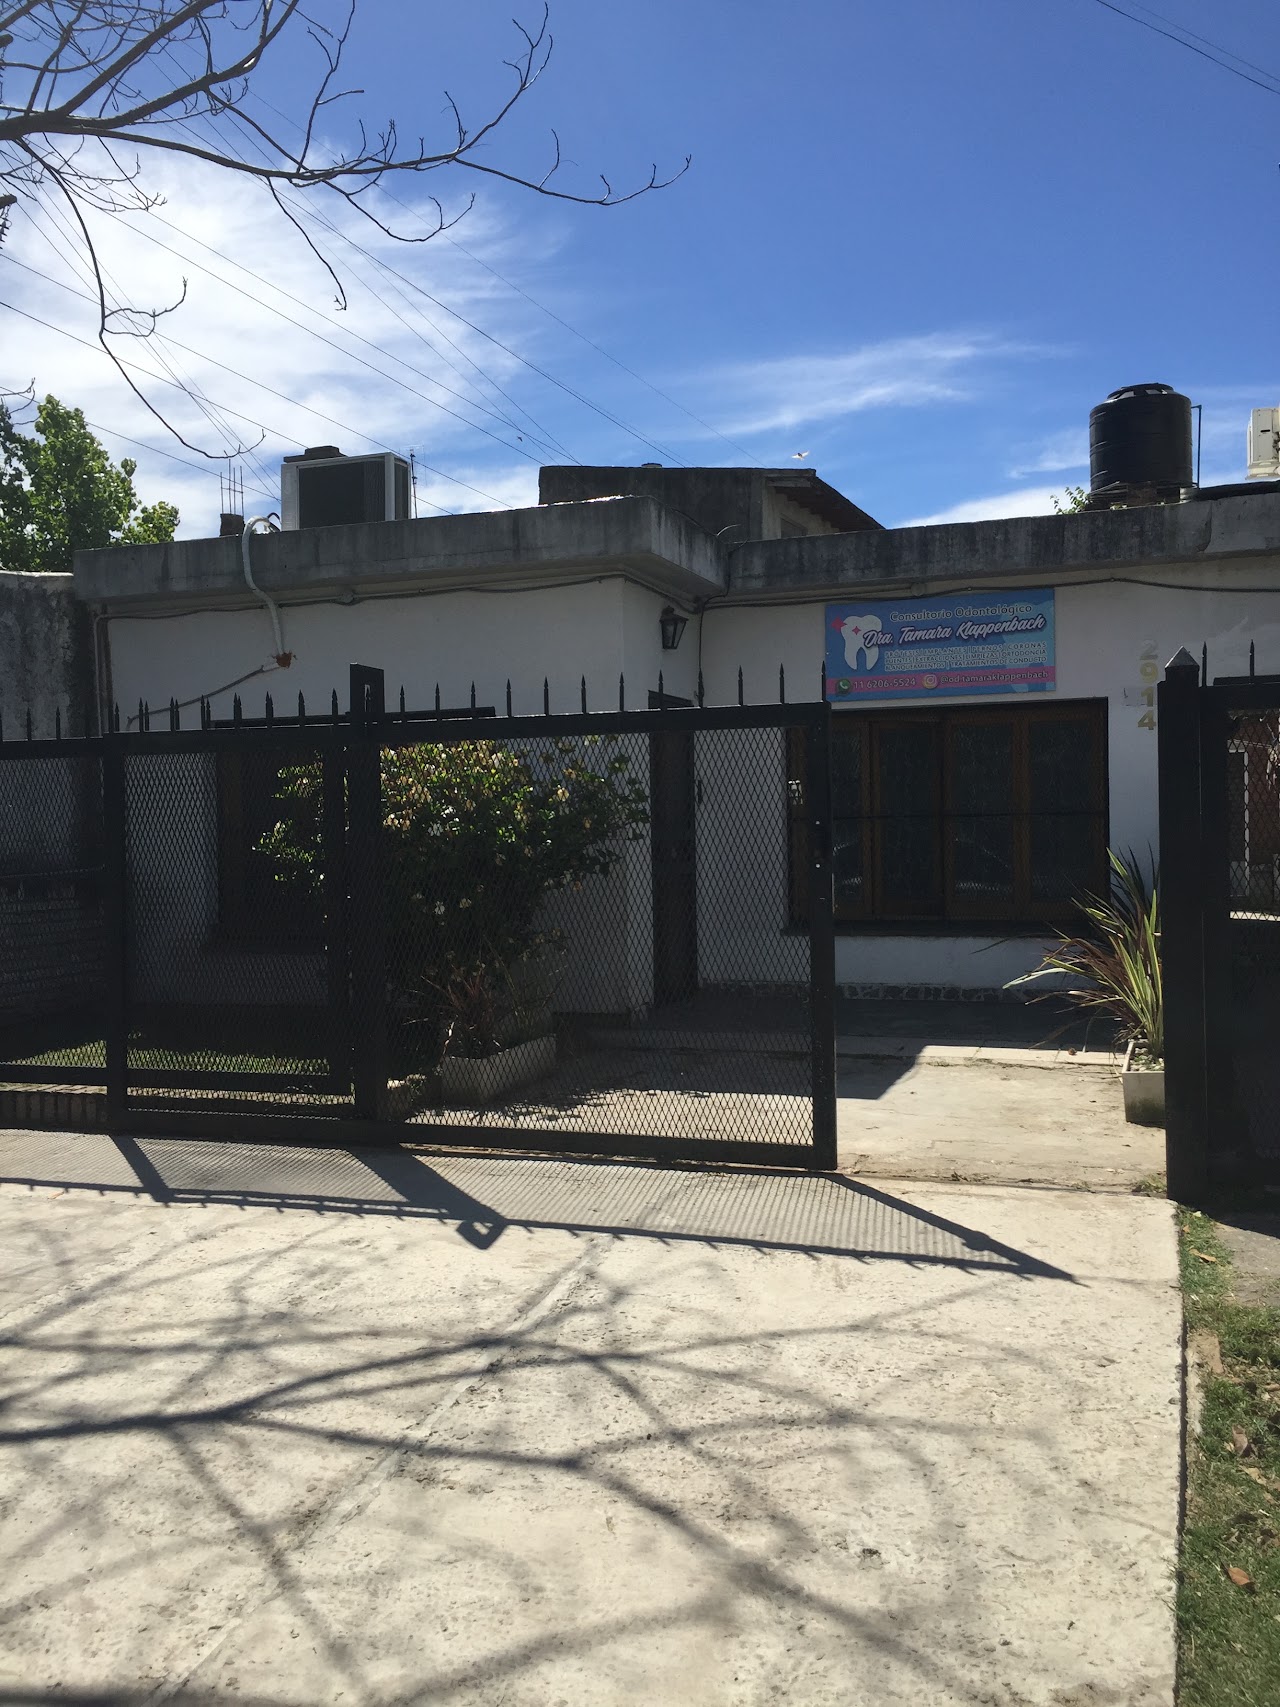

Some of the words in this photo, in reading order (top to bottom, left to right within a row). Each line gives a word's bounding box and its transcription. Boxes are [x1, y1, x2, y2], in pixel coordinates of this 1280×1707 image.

[891, 609, 951, 622] Consultorio
[956, 604, 1031, 617] Odontológico
[863, 630, 893, 648] Dra.
[899, 625, 953, 643] Tamara
[956, 614, 1046, 639] Klappenbach
